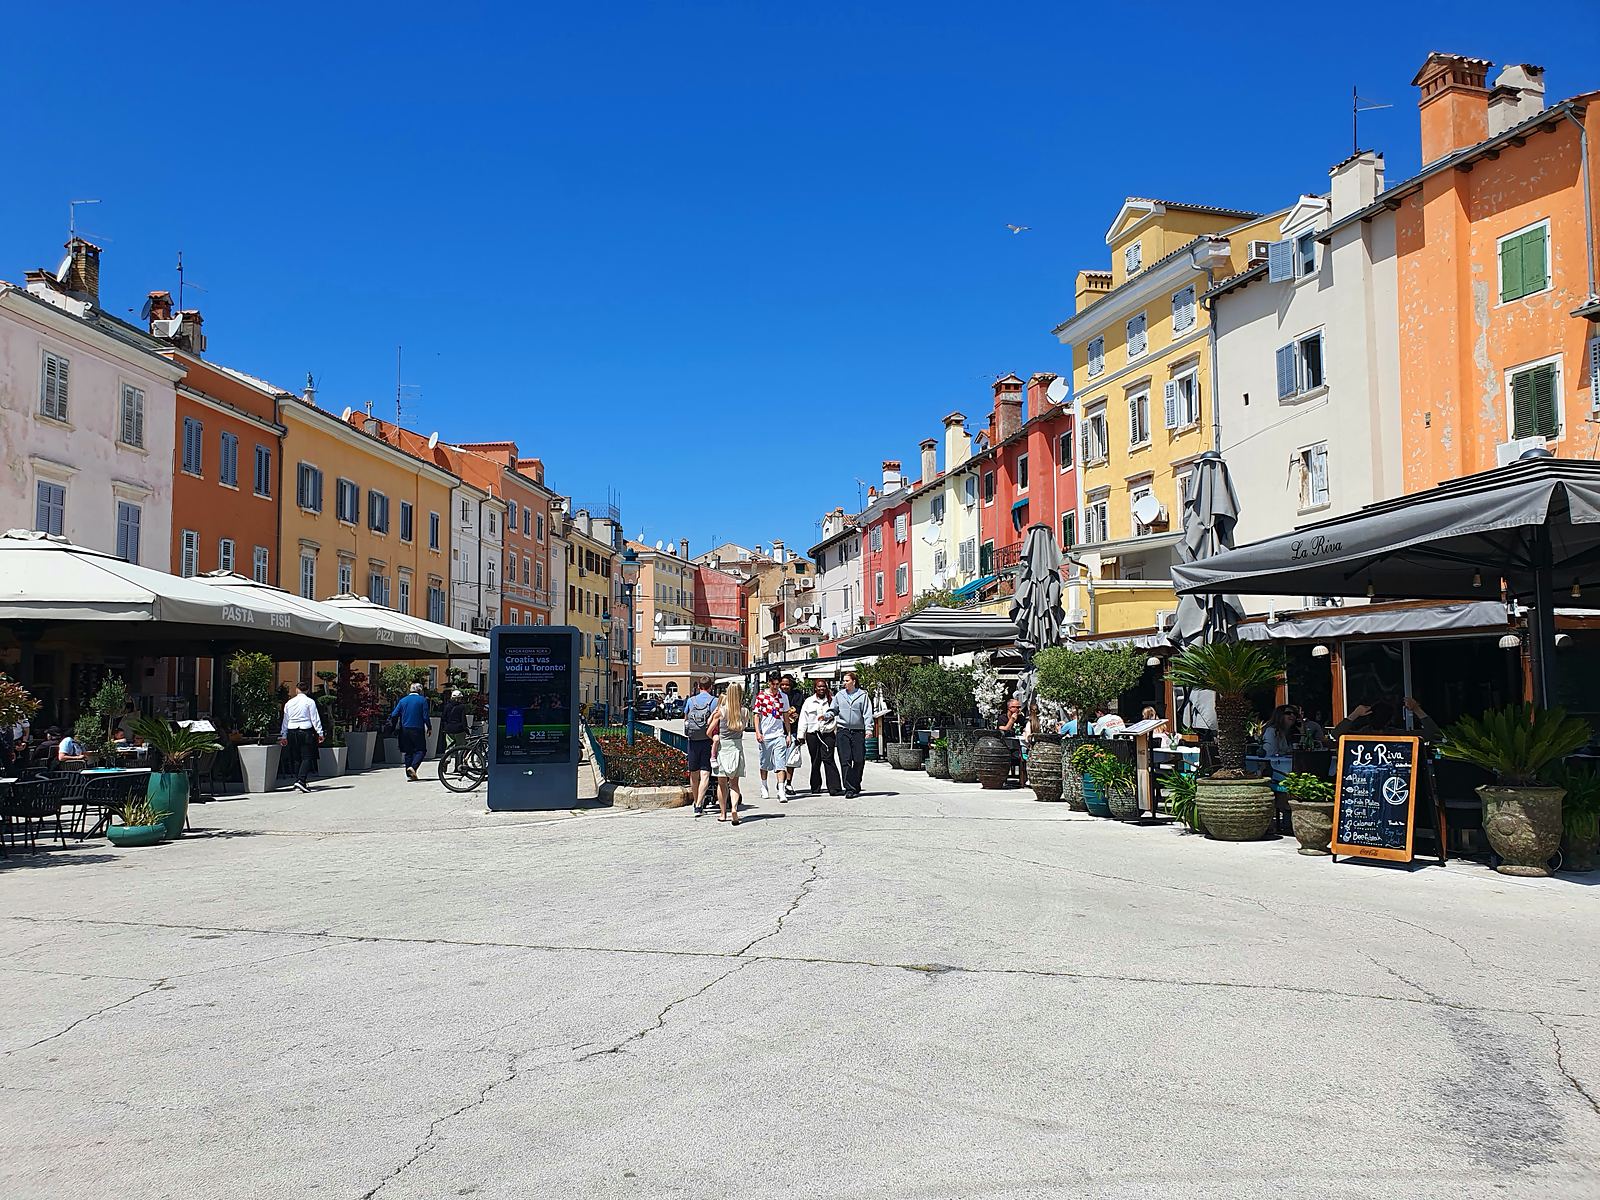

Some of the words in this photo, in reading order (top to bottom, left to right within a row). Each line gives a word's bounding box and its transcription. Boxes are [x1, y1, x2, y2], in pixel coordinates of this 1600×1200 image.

[1291, 540, 1309, 560] La
[1311, 535, 1343, 556] Riva
[222, 606, 254, 623] PASTA
[270, 613, 291, 628] FISH
[376, 629, 395, 642] PIZZA
[403, 634, 420, 646] GRILL
[505, 655, 535, 664] Croatia
[505, 663, 523, 671] vodi
[1351, 744, 1372, 765] La
[1374, 744, 1404, 764] Riva
